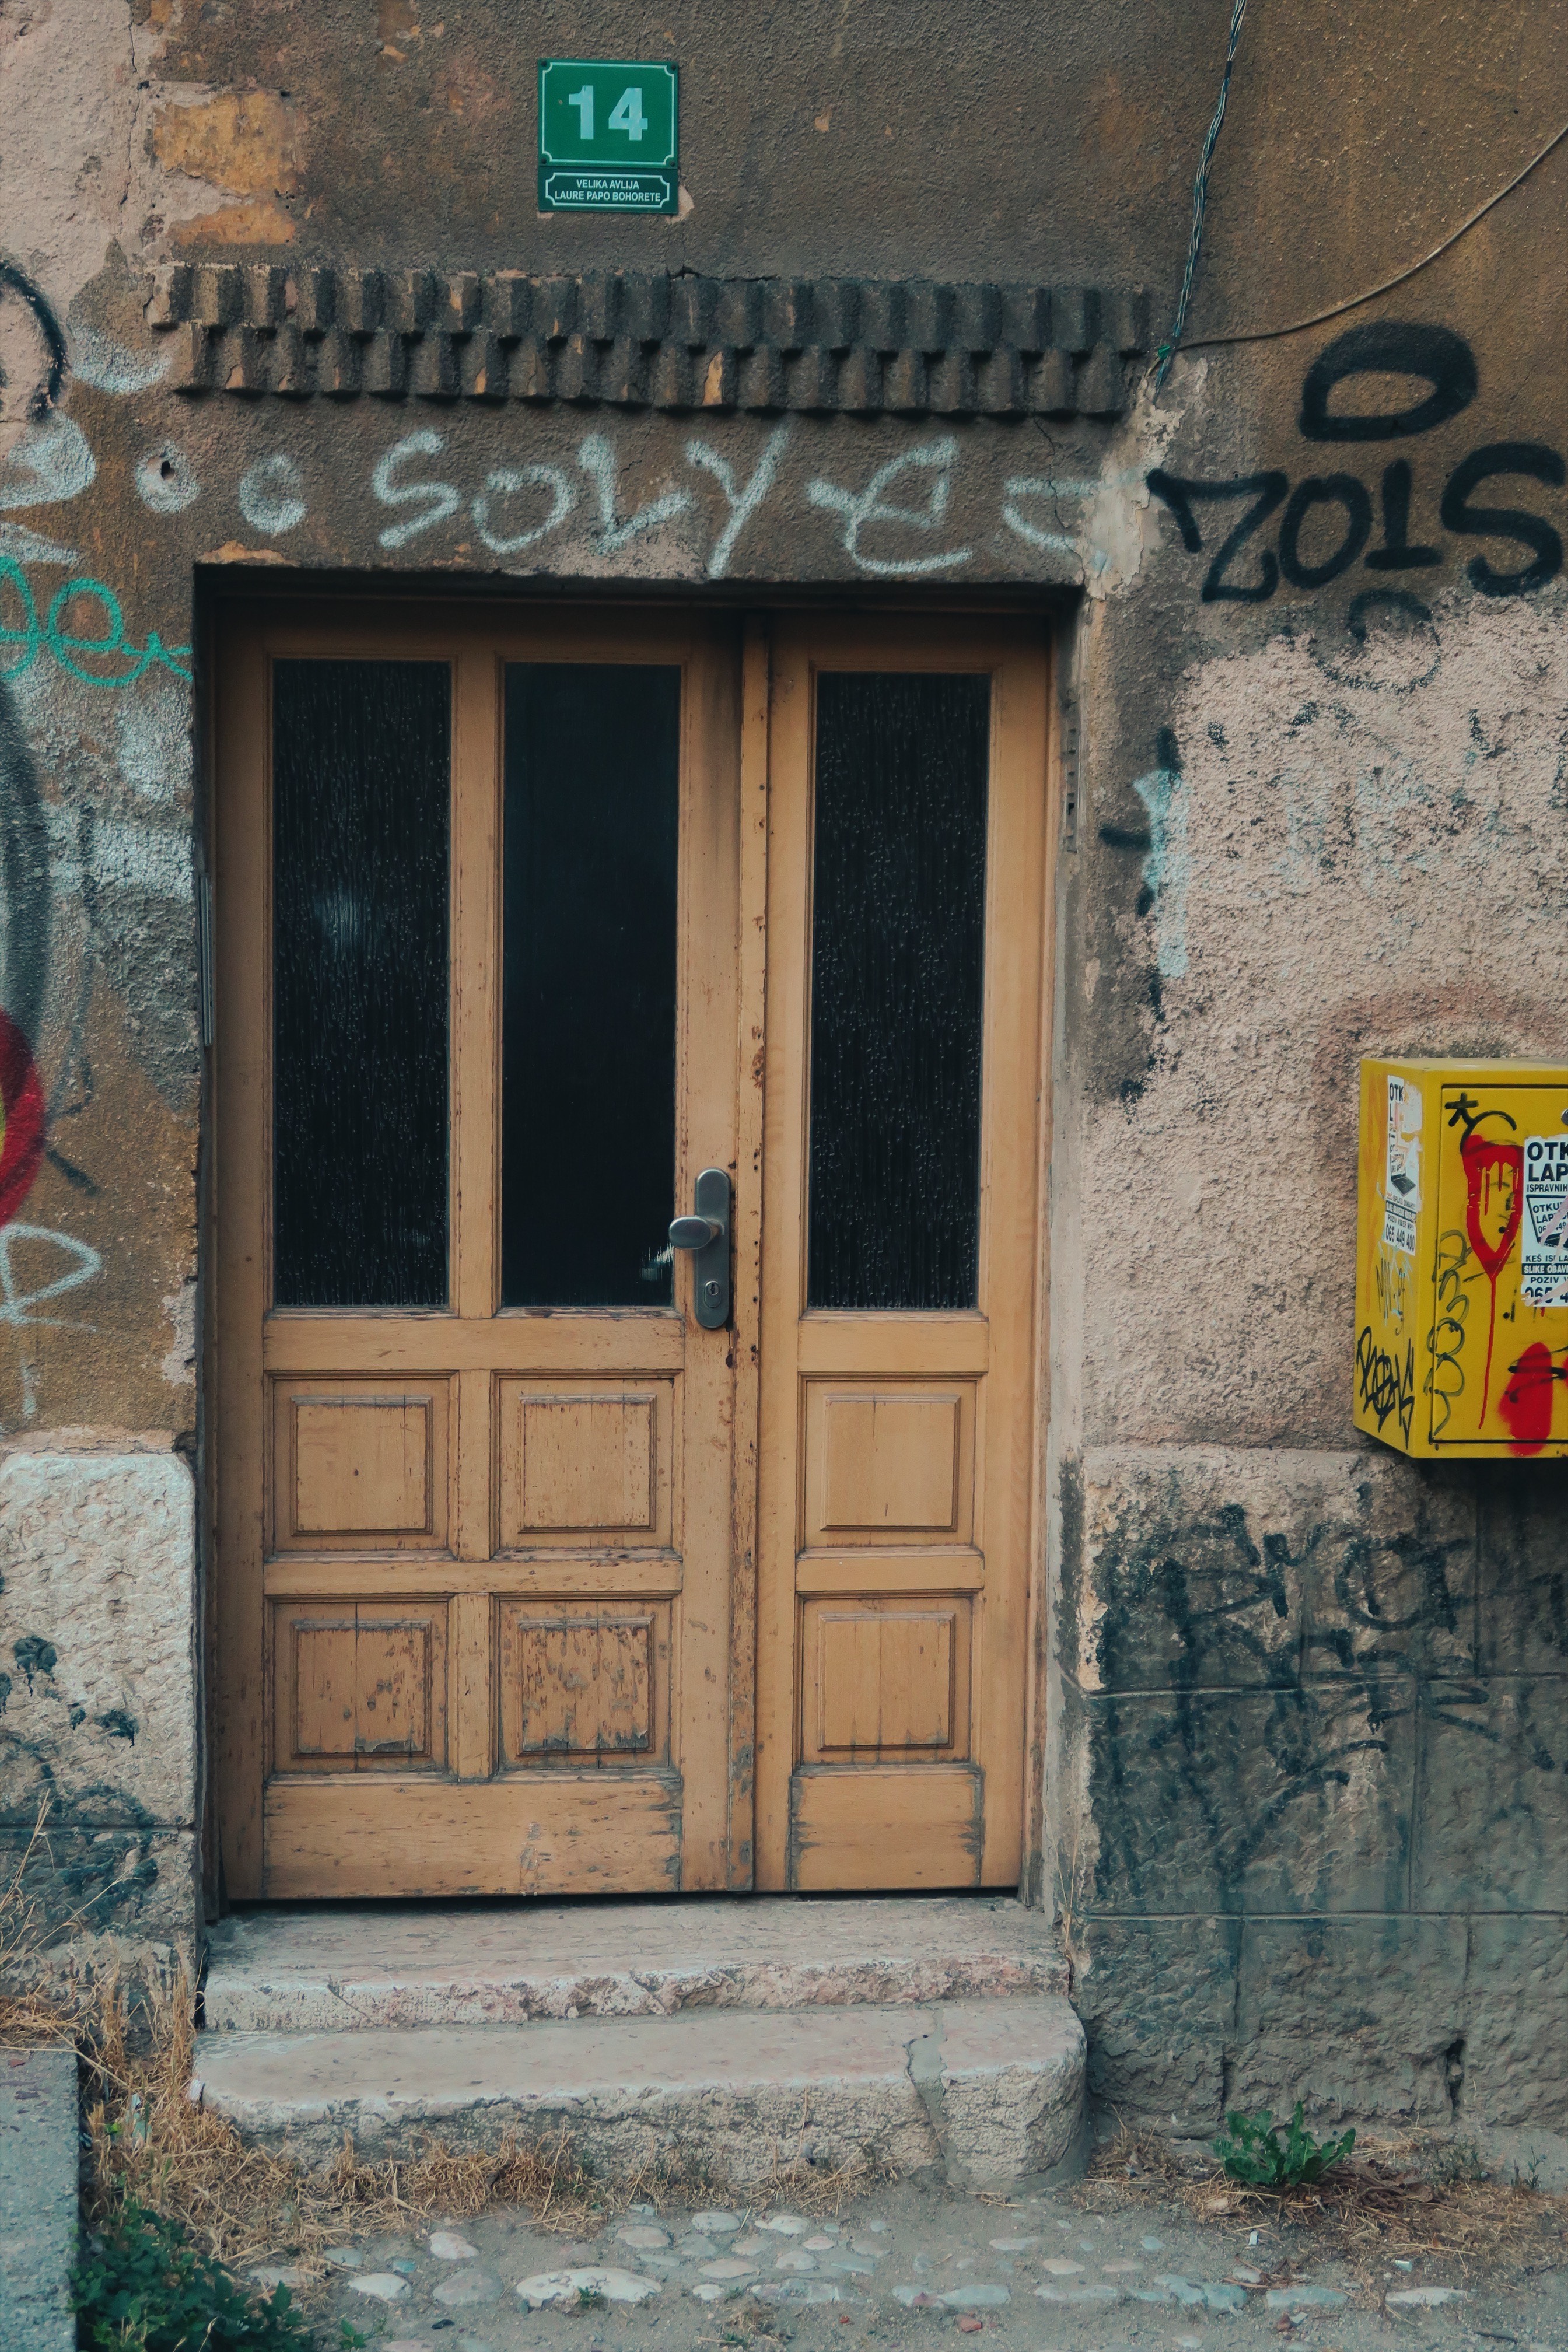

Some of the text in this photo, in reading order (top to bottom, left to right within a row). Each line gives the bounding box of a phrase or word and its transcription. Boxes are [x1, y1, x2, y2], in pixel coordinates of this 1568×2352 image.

[569, 85, 648, 141] 14
[576, 179, 639, 190] VELIKA AVLIJA
[555, 190, 661, 202] LAURE PAPO BOHORETE
[1528, 1163, 1568, 1182] LAP
[1527, 1184, 1568, 1192] ISPRAVNIH
[1532, 1202, 1562, 1213] OTKU
[1385, 1223, 1395, 1242] 065
[1396, 1228, 1405, 1248] 449
[1406, 1233, 1415, 1252] 400
[1525, 1253, 1542, 1262] KEŠ
[1524, 1265, 1545, 1274] SLIKE
